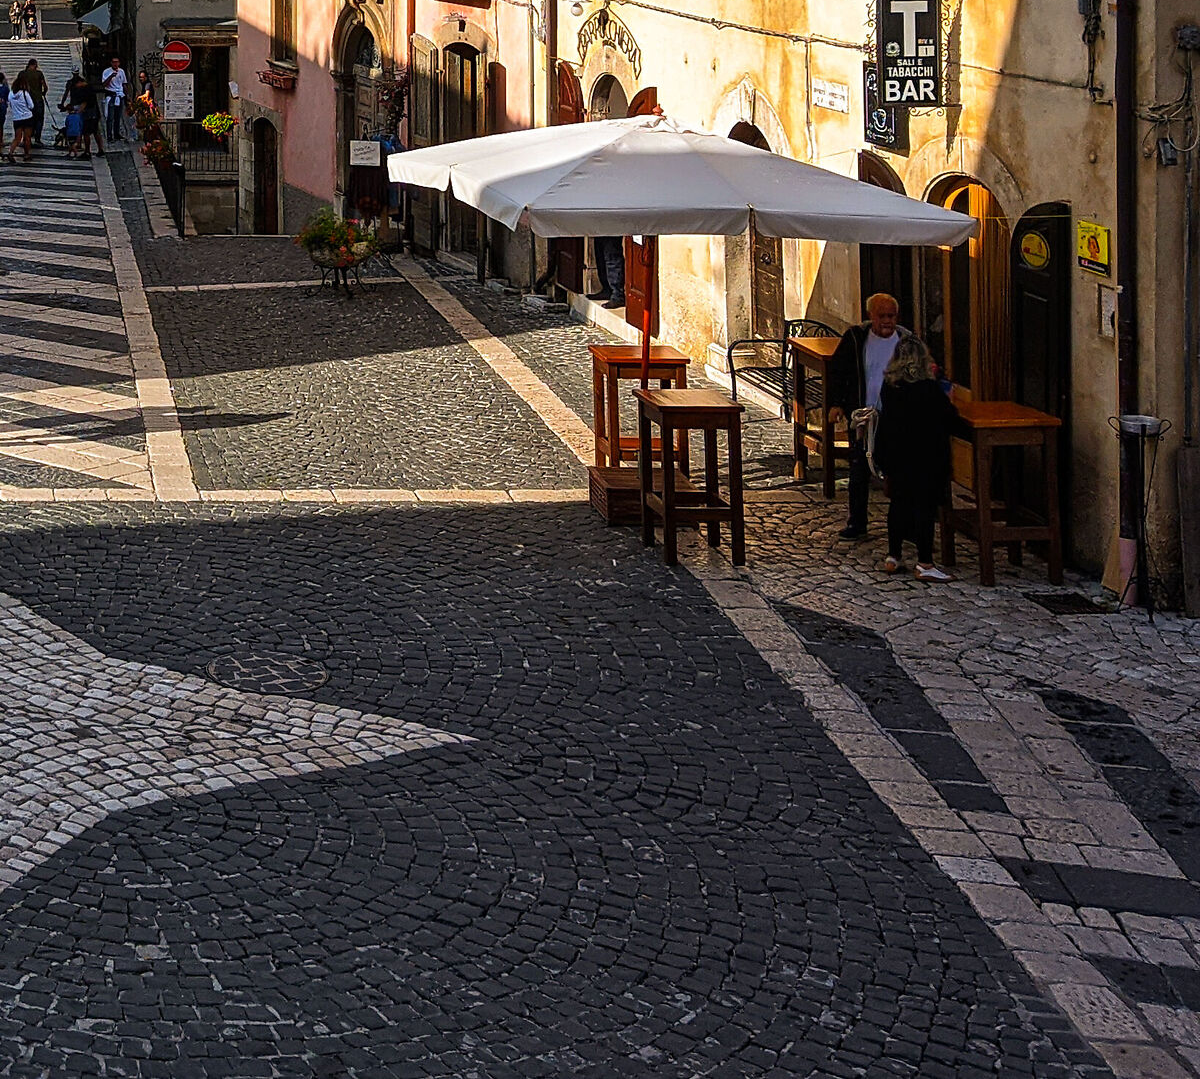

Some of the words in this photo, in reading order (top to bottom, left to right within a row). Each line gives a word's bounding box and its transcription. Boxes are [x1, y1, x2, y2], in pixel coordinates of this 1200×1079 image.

[890, 1, 929, 57] T
[887, 66, 934, 77] TABACCHI
[885, 79, 936, 102] BAR
